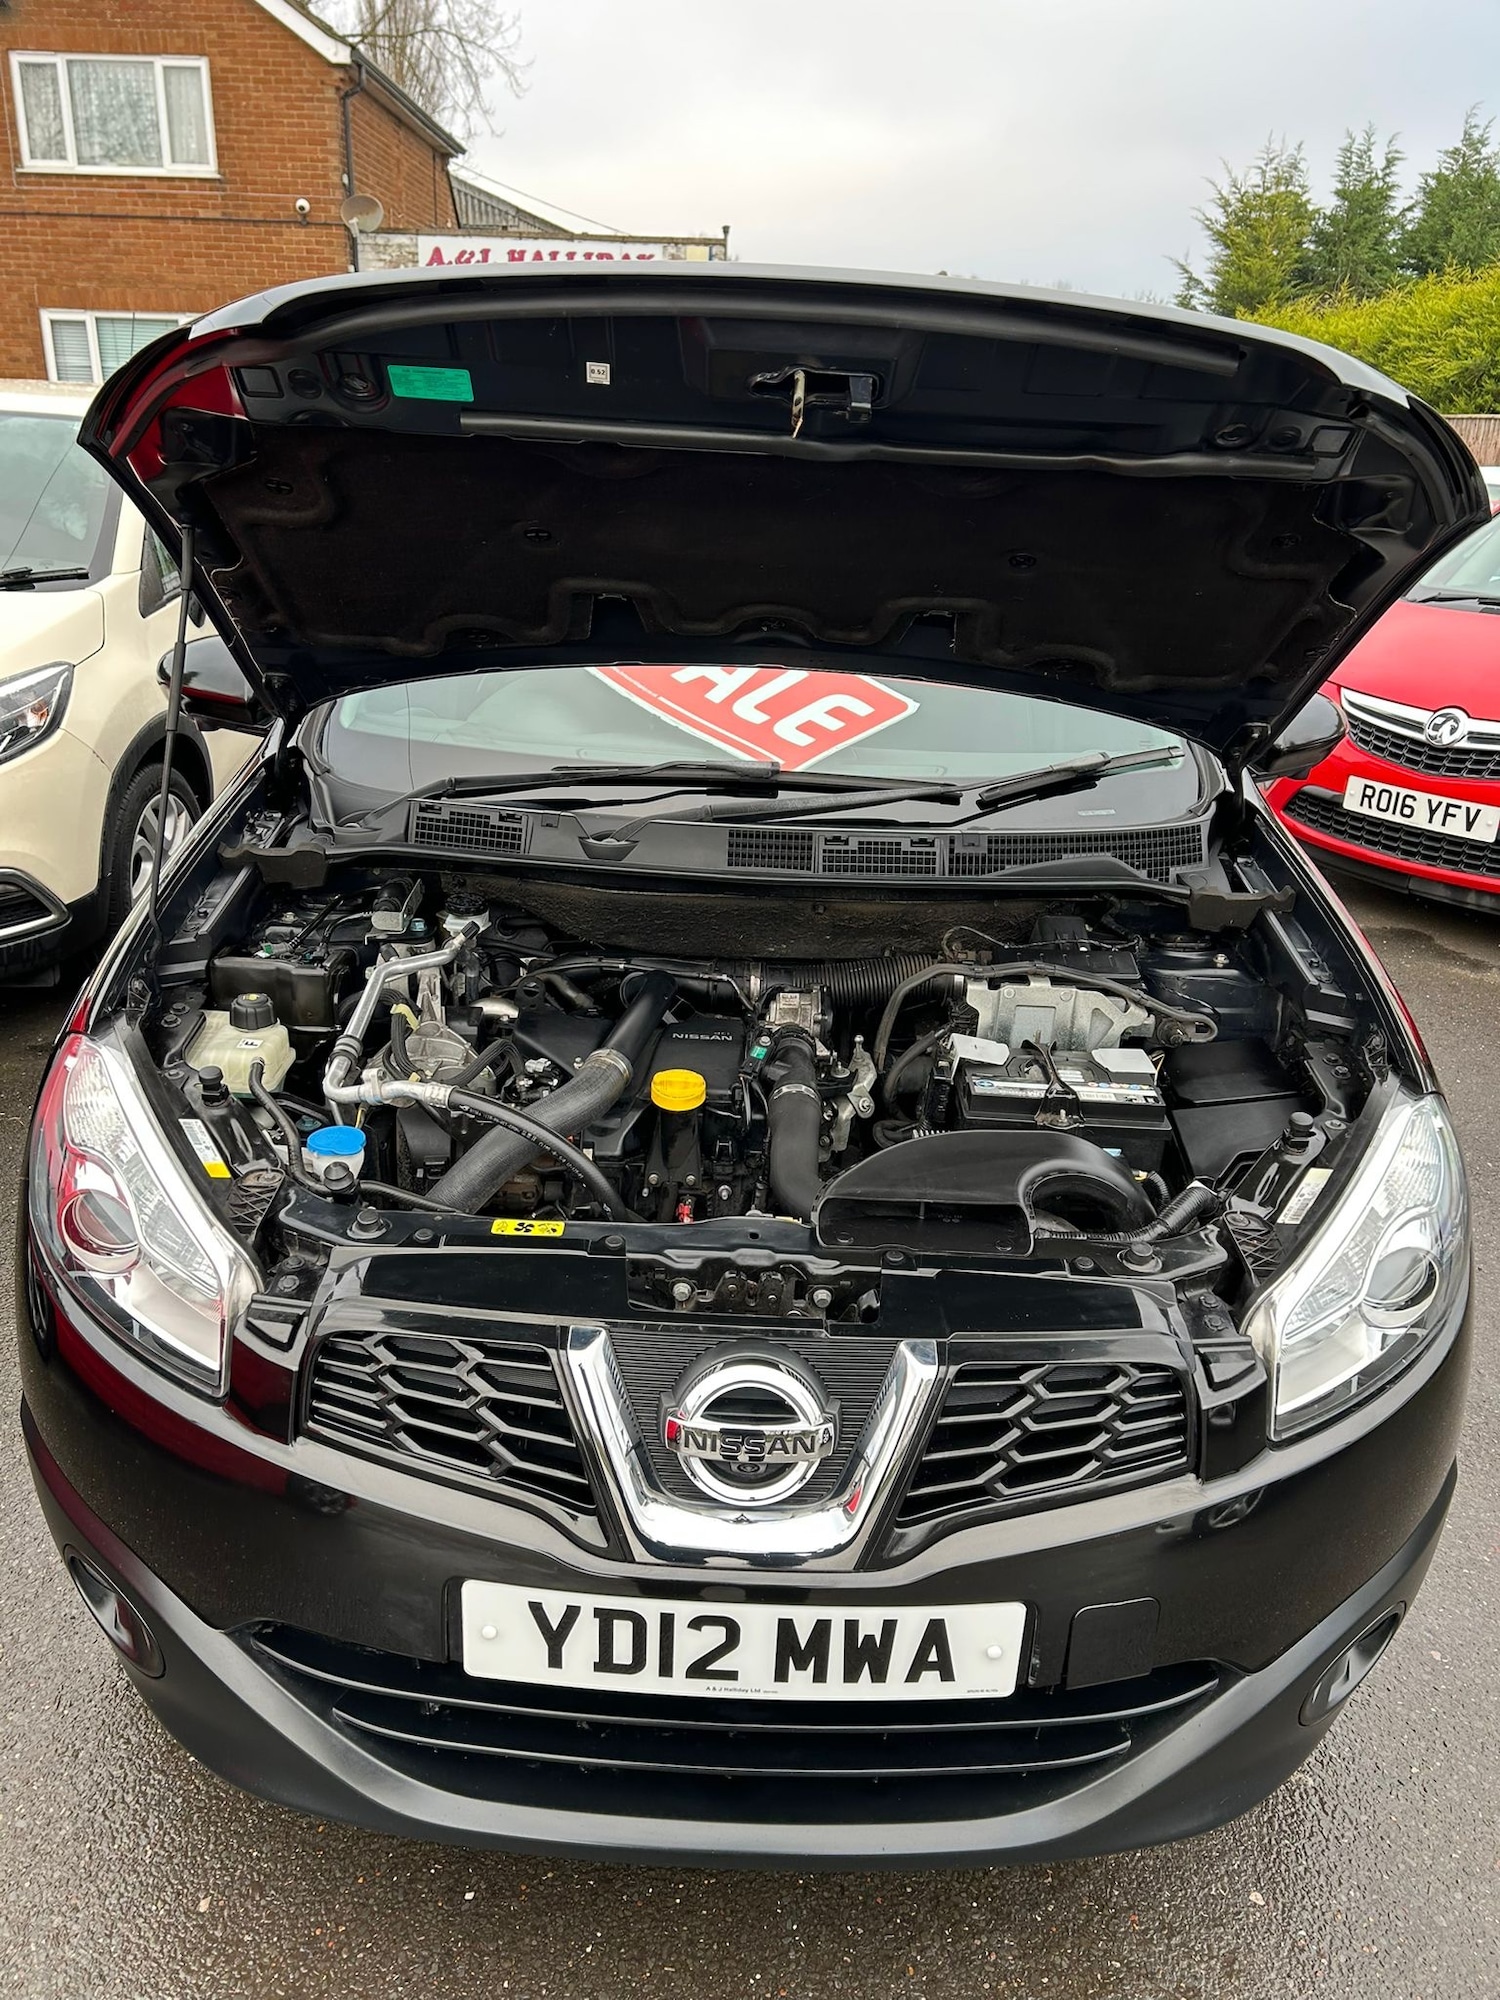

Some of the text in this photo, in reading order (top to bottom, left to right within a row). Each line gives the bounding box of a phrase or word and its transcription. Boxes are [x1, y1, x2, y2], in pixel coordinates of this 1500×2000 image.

[1360, 784, 1482, 832] RO16 YFV
[672, 1033, 733, 1041] NISSAN
[684, 1428, 816, 1457] NISSAN
[527, 1600, 957, 1684] YD12 MWA
